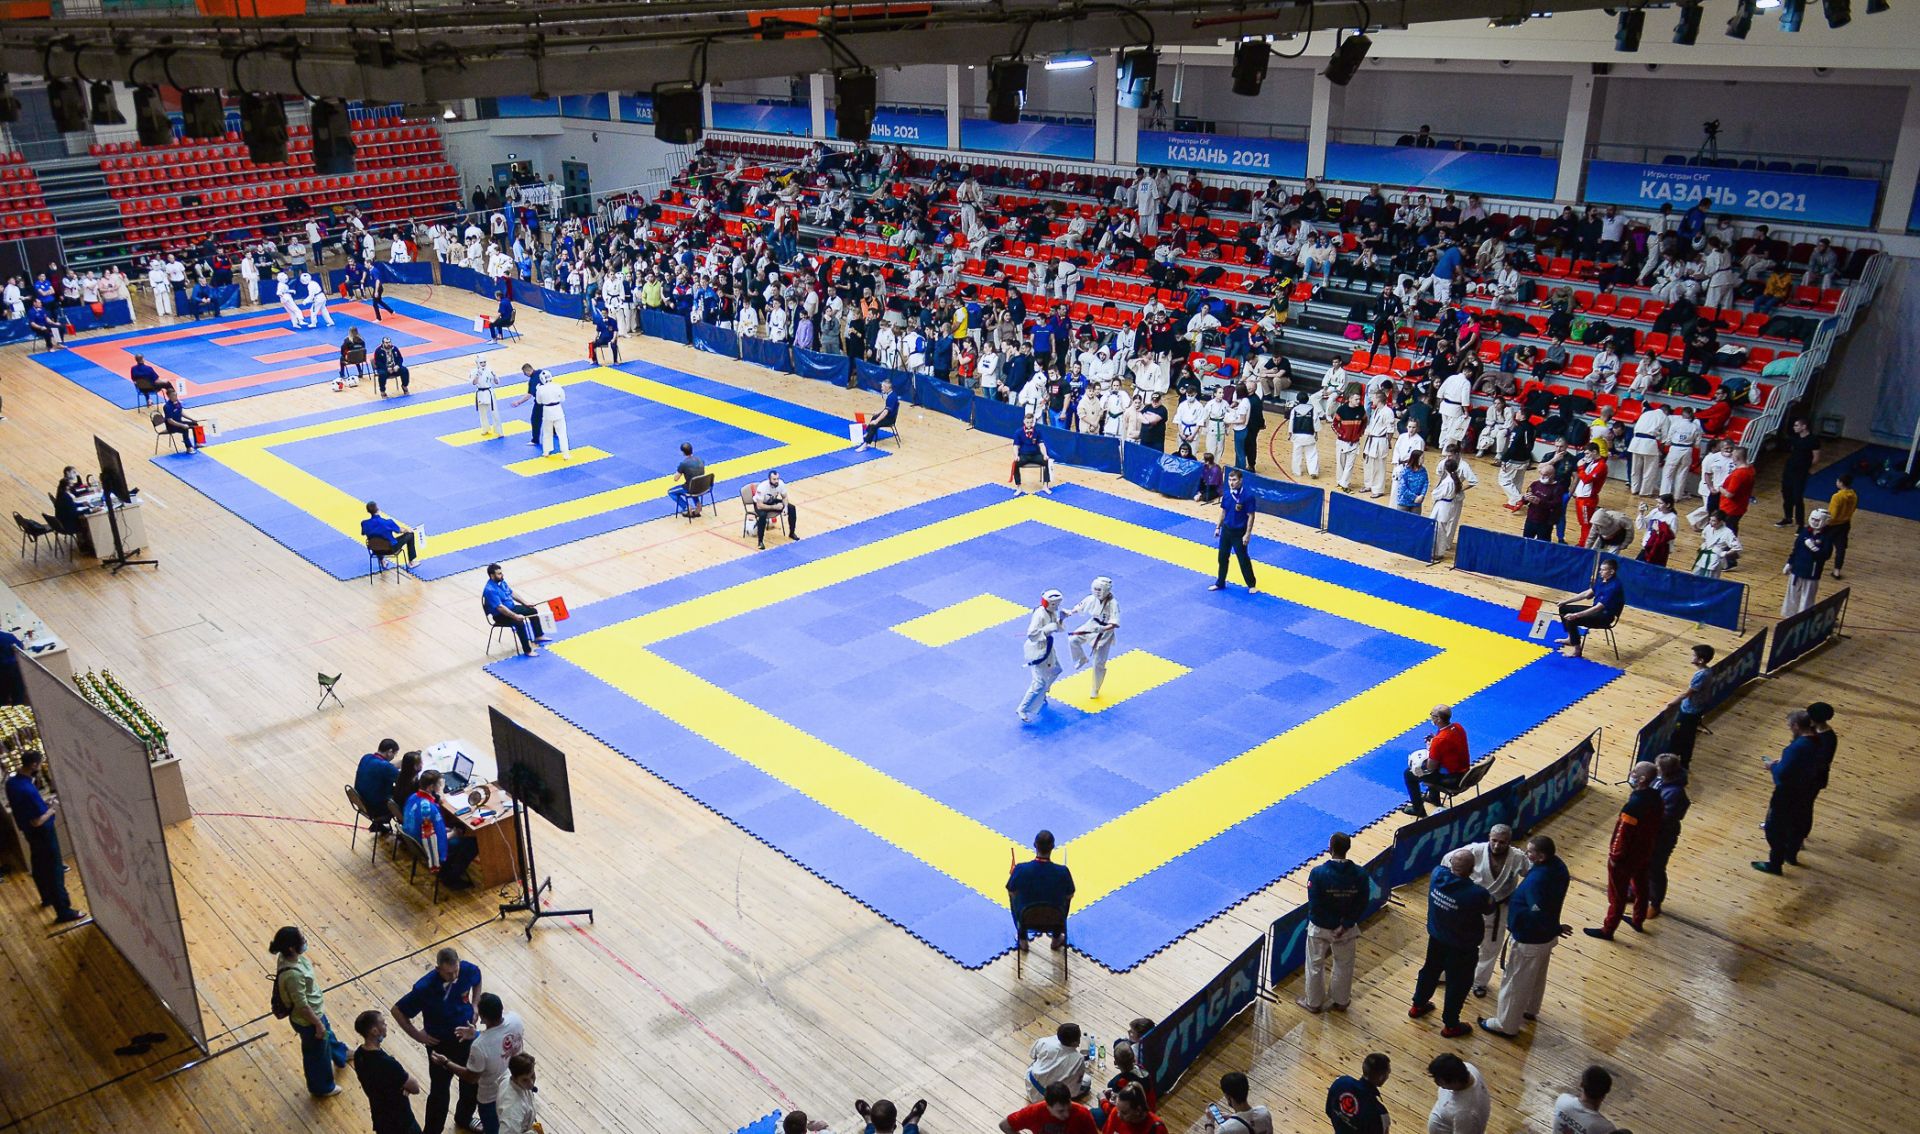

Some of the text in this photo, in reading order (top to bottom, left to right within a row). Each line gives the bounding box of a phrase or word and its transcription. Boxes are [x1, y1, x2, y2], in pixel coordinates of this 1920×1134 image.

[636, 107, 653, 118] КАЗ
[870, 123, 919, 139] АНЬ 2021
[1167, 145, 1271, 168] КАЗАНЬ 2021
[1647, 170, 1669, 179] Игры
[1670, 173, 1692, 181] стран
[1693, 173, 1711, 181] СНГ
[1639, 180, 1806, 212] КАЗАНЬ 2021
[1511, 758, 1586, 830] STIGA
[1403, 800, 1504, 871] STIGA
[1156, 968, 1252, 1083] STIGA
